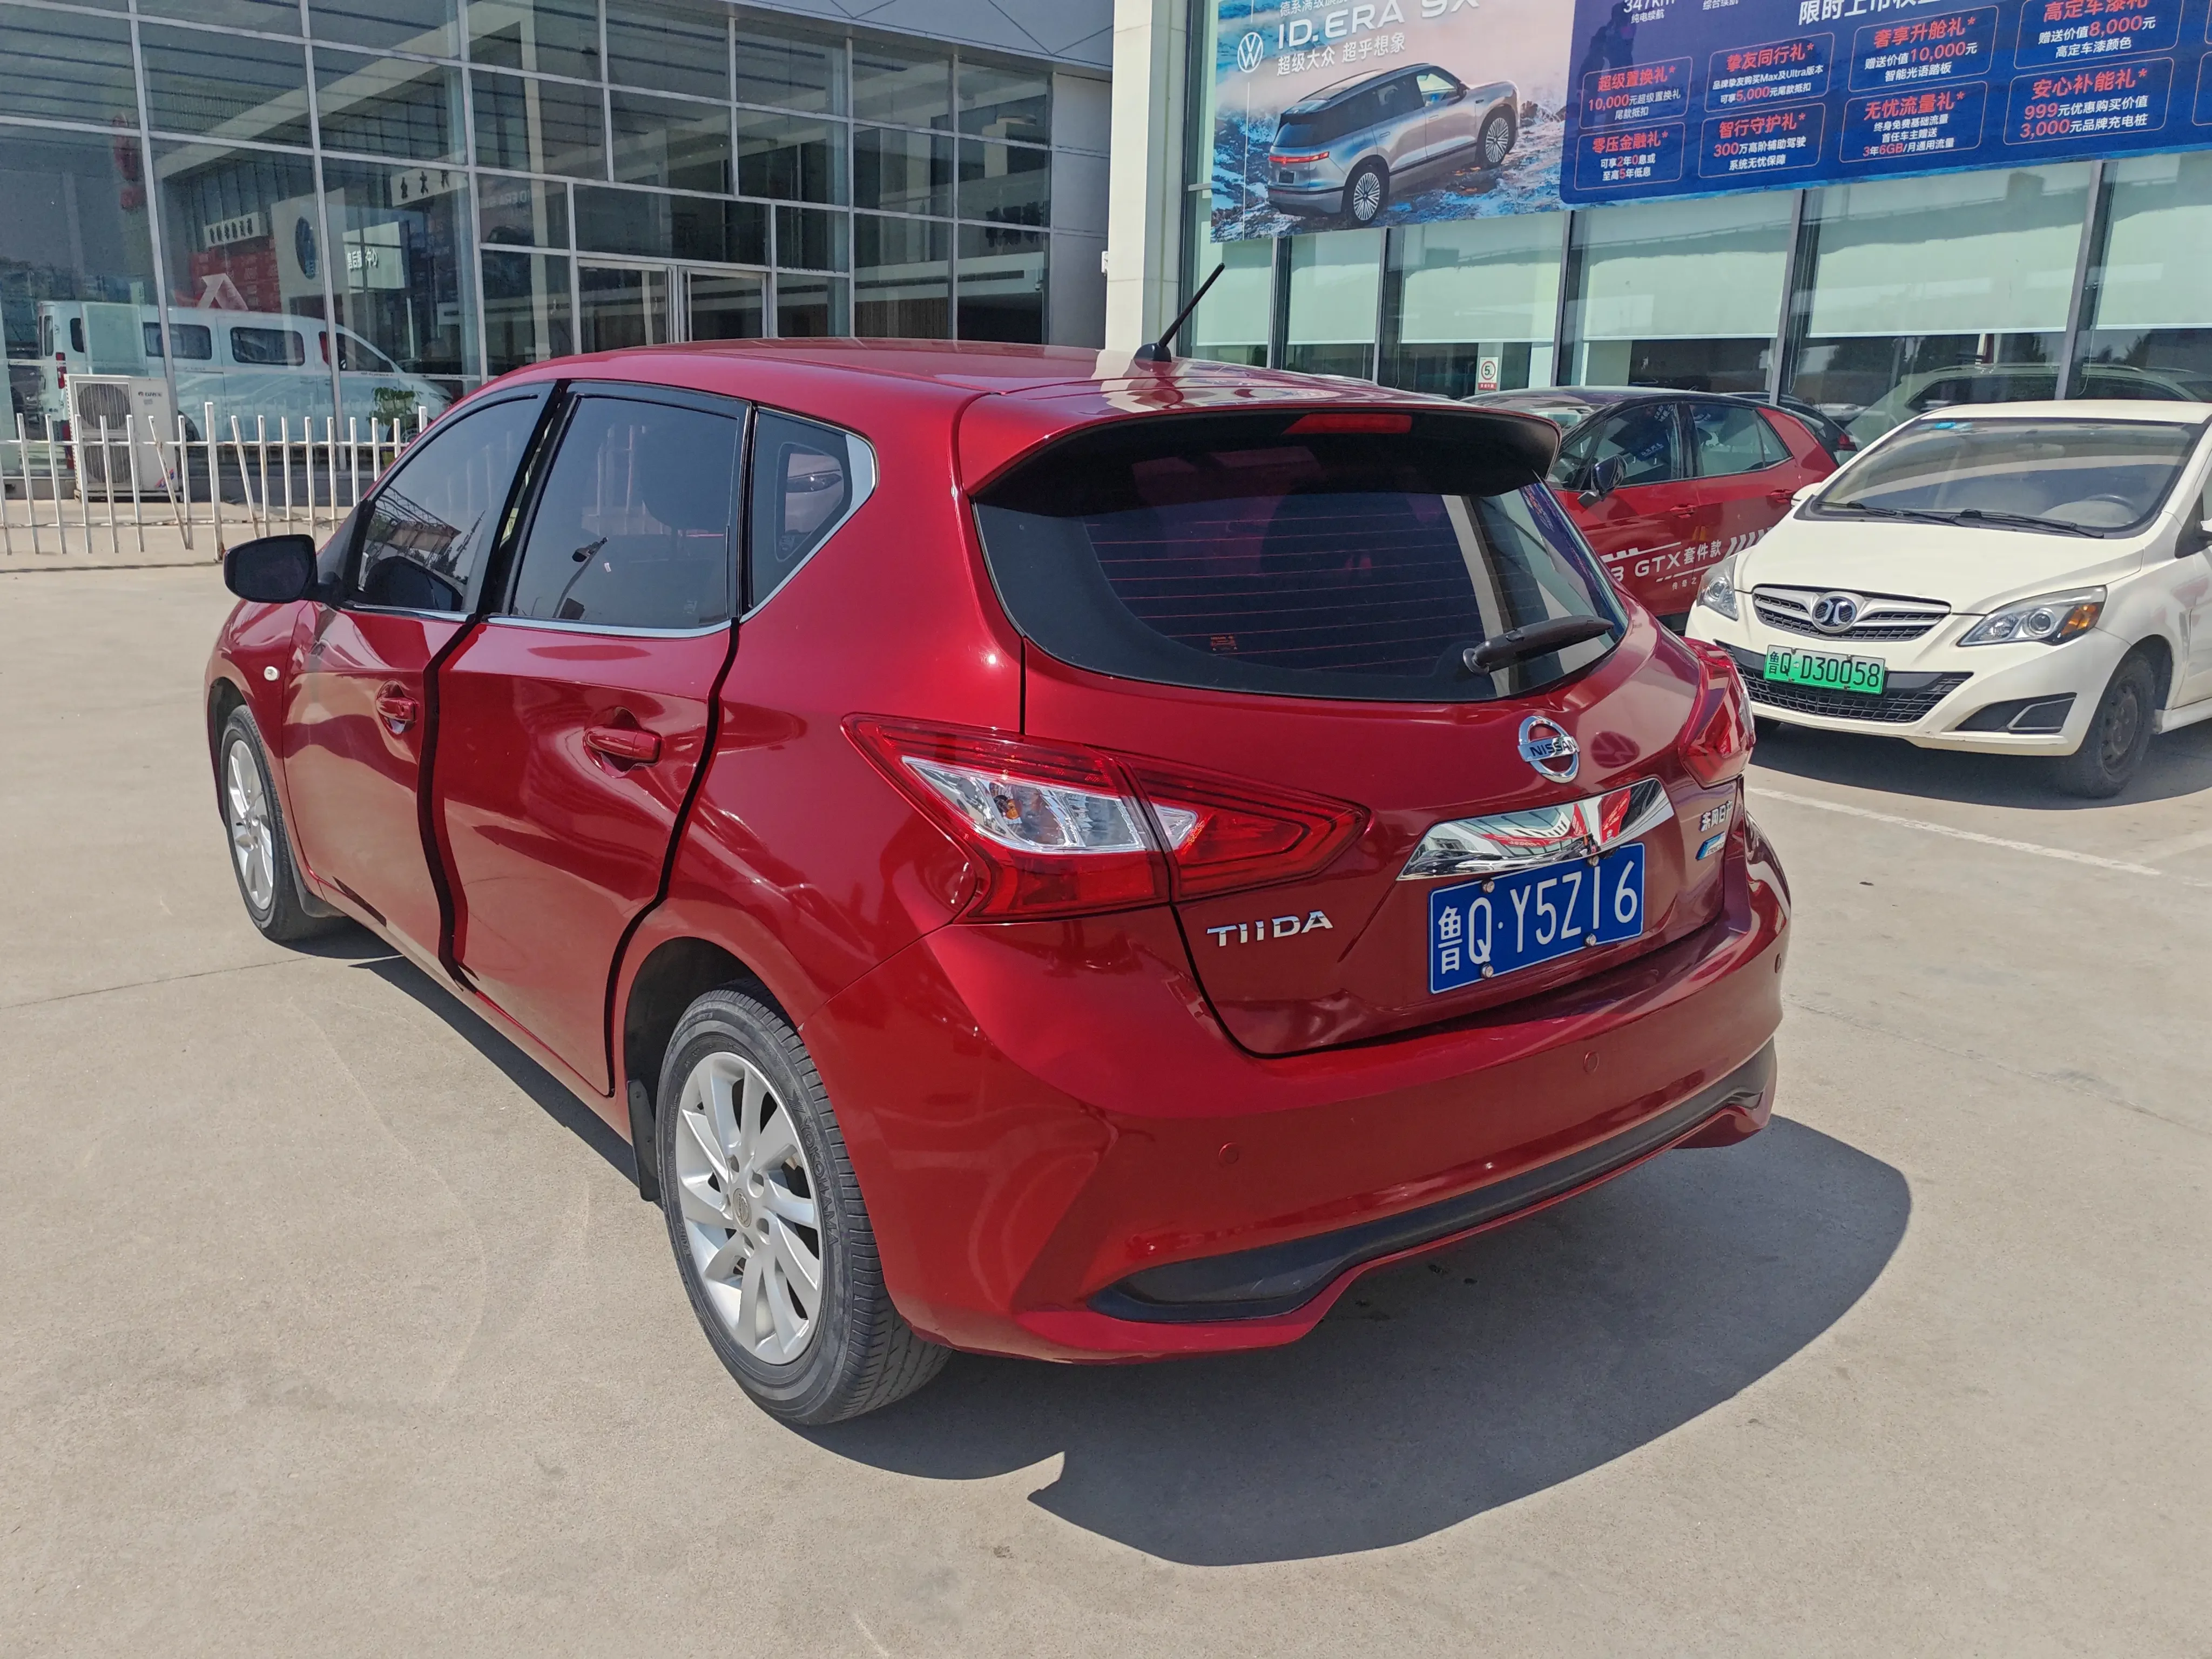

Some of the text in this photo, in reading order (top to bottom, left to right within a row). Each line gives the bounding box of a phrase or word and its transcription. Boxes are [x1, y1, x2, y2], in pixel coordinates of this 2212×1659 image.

[1278, 0, 1405, 50] ID.ERA
[1631, 9, 1665, 24] 纯电续航
[1798, 0, 1942, 26] 限时上市
[2038, 15, 2156, 45] 赠送价值8,000元
[1277, 32, 1406, 76] 超级大众 超乎想象
[1864, 42, 1978, 70] 赠送价值10,000元
[2055, 36, 2133, 59] 高定车漆颜色
[1885, 61, 1953, 83] 智能光语踏板
[2024, 95, 2150, 120] 999元优惠购买价值
[2020, 113, 2149, 140] 3,000元品牌充电桩
[1485, 365, 1490, 375] 5
[1635, 551, 1681, 577] GTX
[1683, 539, 1722, 565] 套件款
[1529, 740, 1576, 757] NISSAN
[799, 1115, 839, 1246] YOKOHAMA
